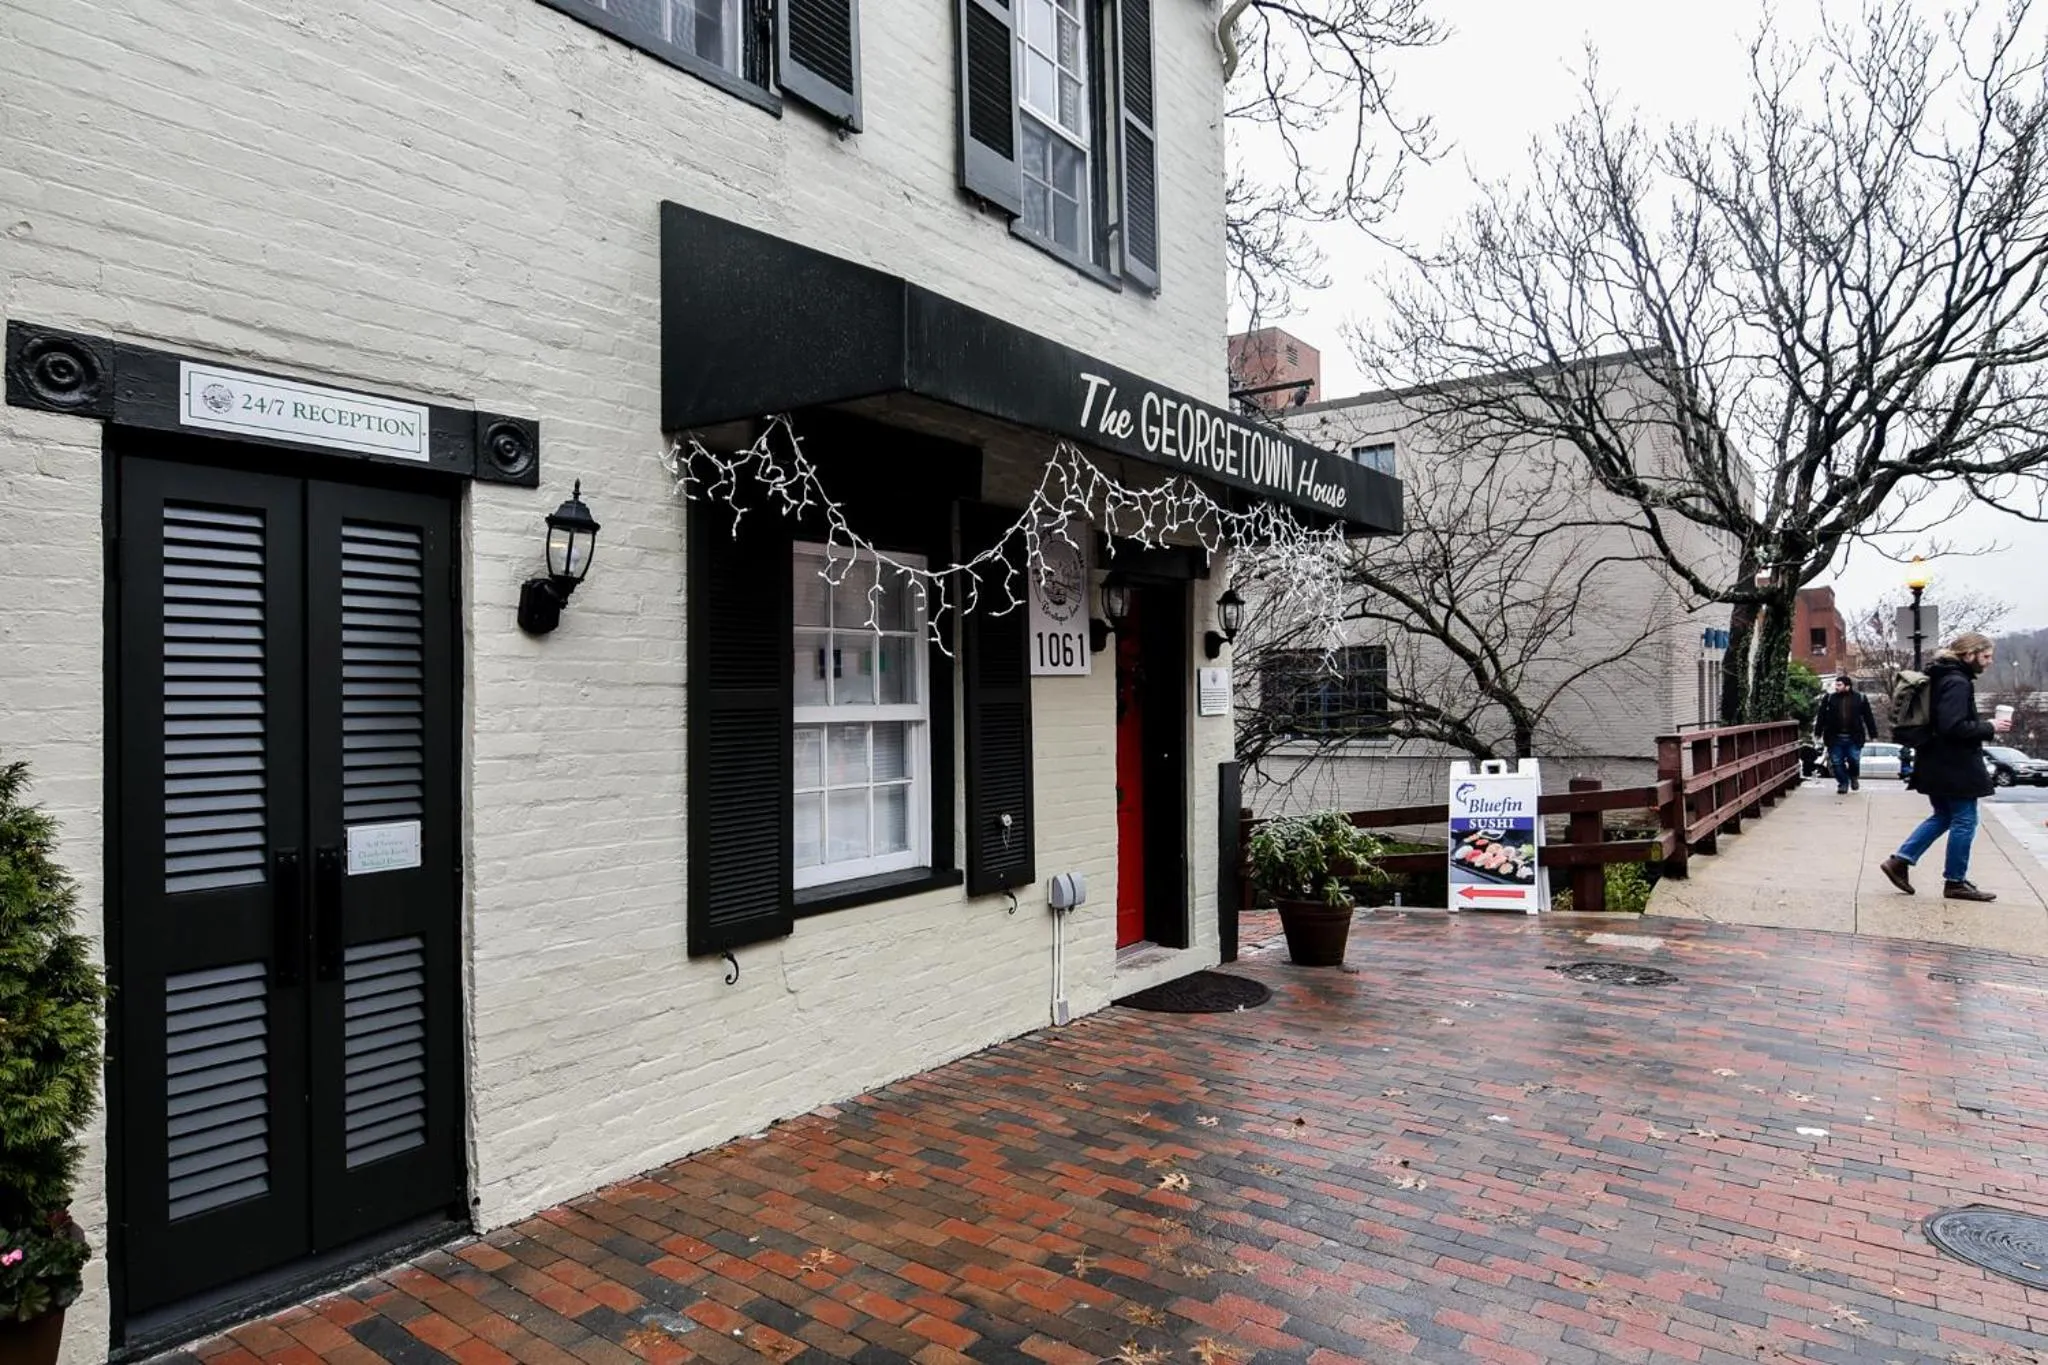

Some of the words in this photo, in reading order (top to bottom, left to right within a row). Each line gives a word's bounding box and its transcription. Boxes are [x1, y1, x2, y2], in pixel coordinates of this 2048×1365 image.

[241, 394, 285, 416] 24/7
[292, 402, 416, 437] RECEPTION
[1080, 372, 1134, 439] The
[1140, 391, 1293, 493] GEORGETOWN
[1297, 458, 1347, 508] House
[1037, 632, 1085, 667] 1061
[1468, 797, 1523, 816] Bluefin
[1468, 818, 1515, 829] SUSHI
